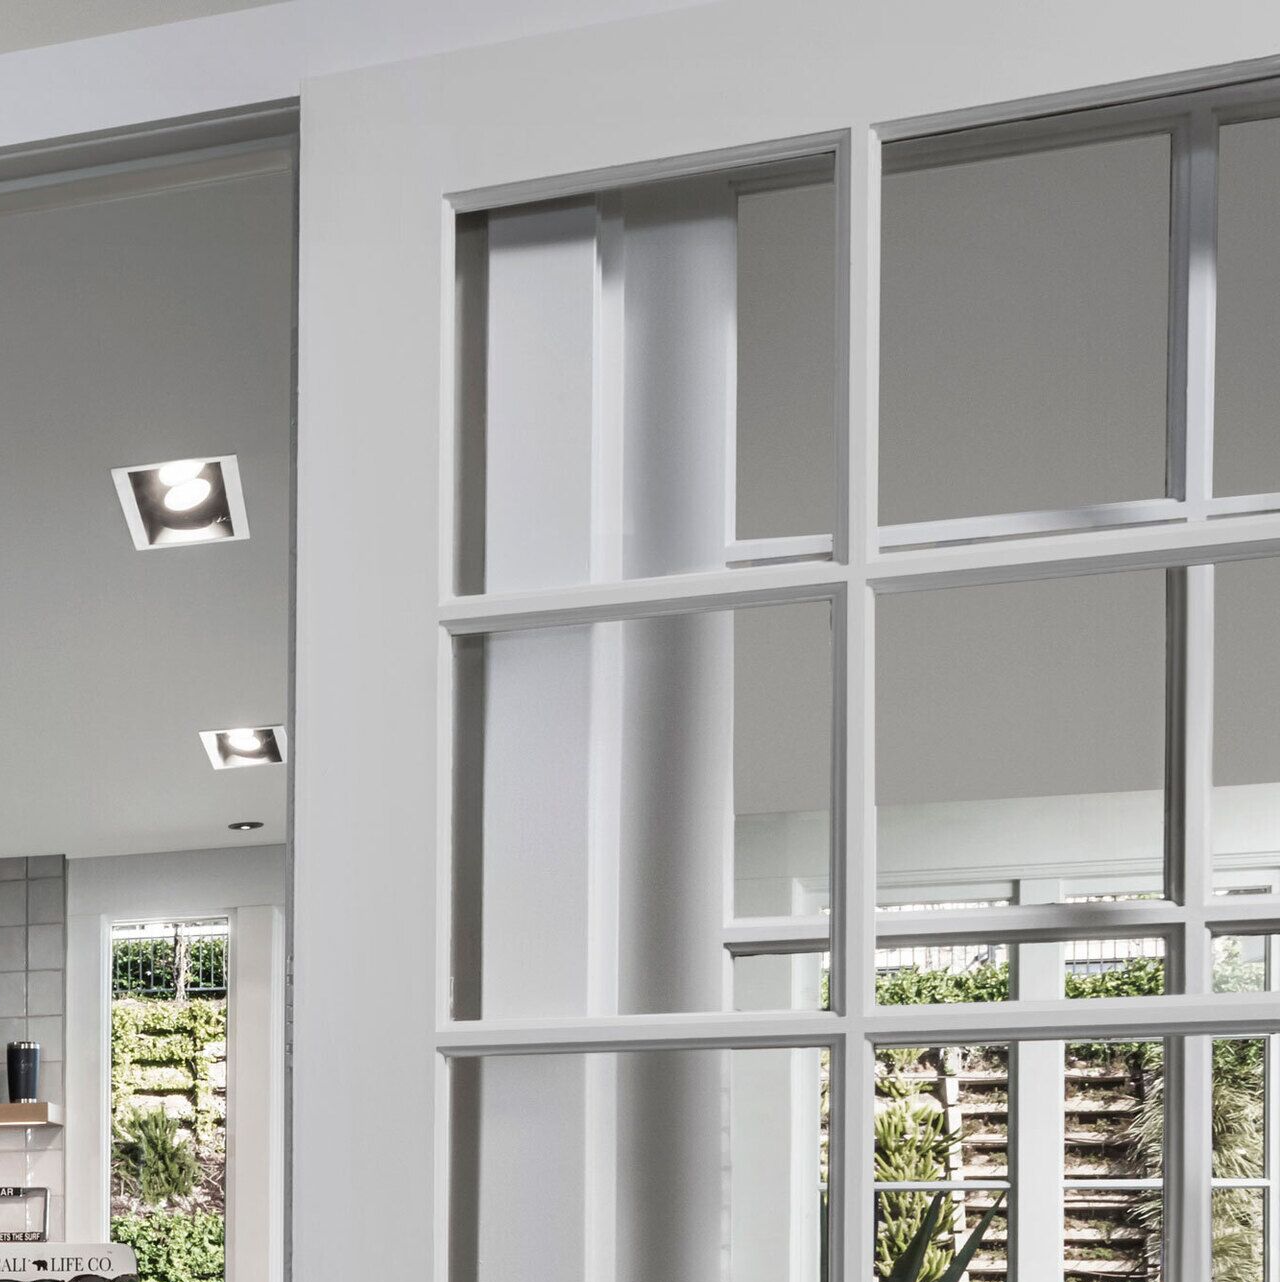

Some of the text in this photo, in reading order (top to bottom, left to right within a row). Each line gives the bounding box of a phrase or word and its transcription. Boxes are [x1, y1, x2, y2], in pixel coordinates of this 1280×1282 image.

[11, 1232, 24, 1241] THE
[24, 1232, 41, 1241] SURF
[51, 1257, 82, 1272] LIFE
[87, 1257, 114, 1272] CO.
